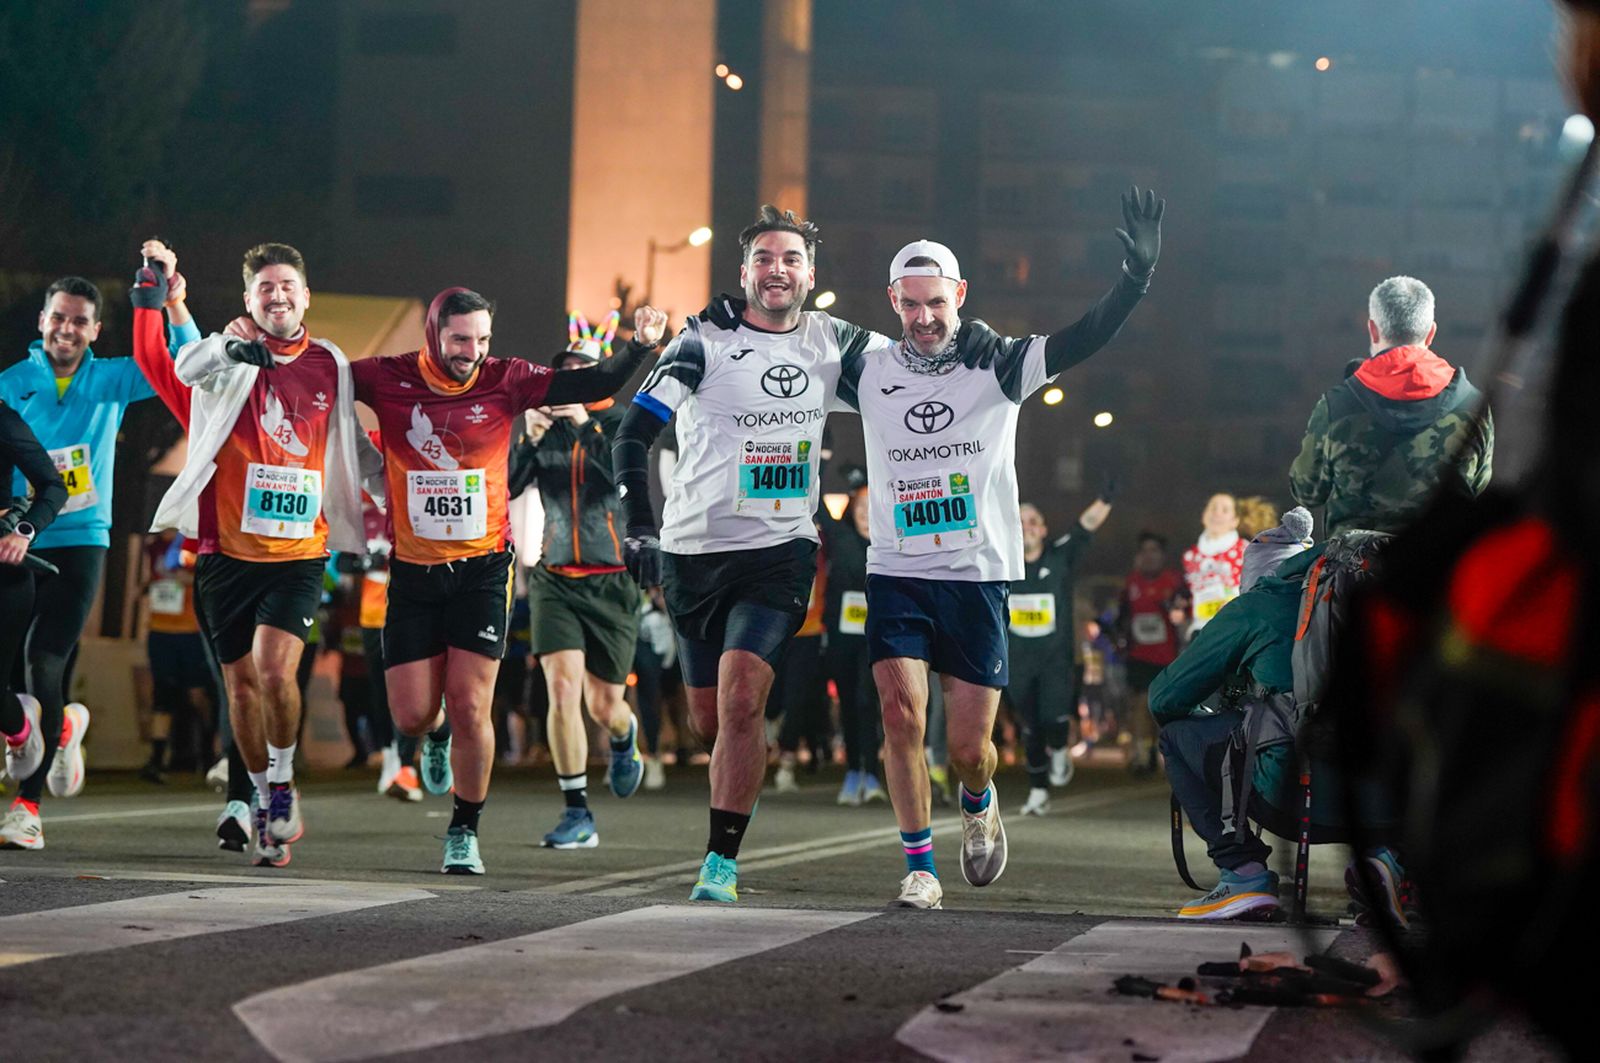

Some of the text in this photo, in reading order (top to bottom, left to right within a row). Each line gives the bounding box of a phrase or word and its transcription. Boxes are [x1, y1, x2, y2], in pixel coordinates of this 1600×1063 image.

[273, 424, 293, 445] 43
[421, 440, 442, 460] 43
[755, 444, 781, 454] NOCHE
[782, 444, 792, 454] DE
[744, 455, 763, 465] SAN
[763, 453, 792, 464] ANTÓN
[255, 481, 272, 489] SAN
[265, 474, 298, 484] NOCHE DE
[749, 465, 804, 490] 14011
[906, 480, 930, 492] NOCHE
[931, 478, 942, 488] DE
[416, 487, 433, 495] SAN
[899, 493, 915, 503] SAN
[914, 488, 944, 501] ANTÓN
[260, 490, 308, 516] 8130
[424, 496, 473, 517] 4631
[901, 496, 968, 528] 14010
